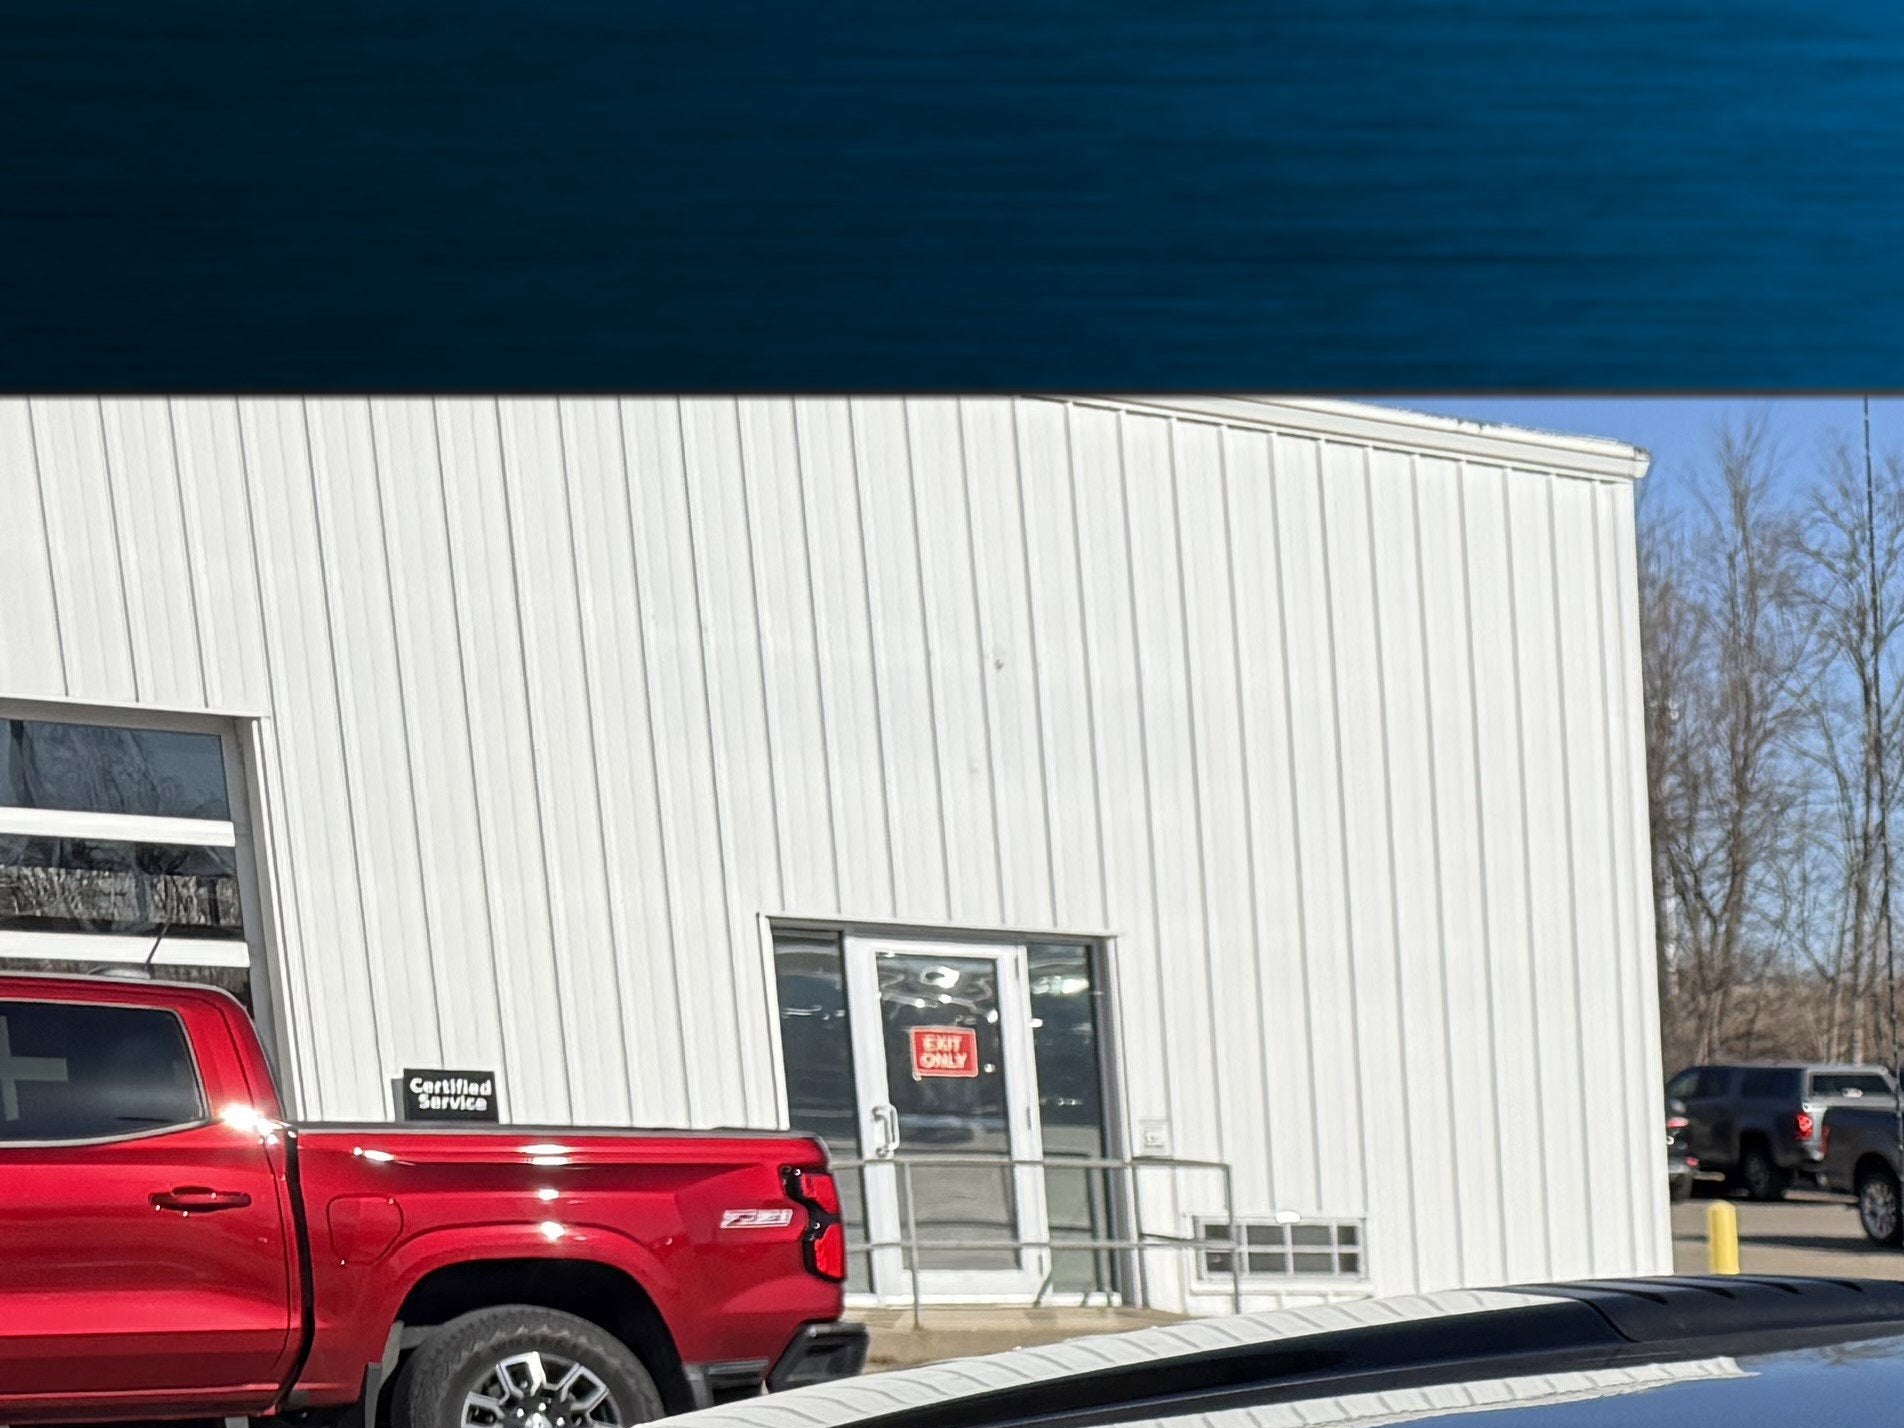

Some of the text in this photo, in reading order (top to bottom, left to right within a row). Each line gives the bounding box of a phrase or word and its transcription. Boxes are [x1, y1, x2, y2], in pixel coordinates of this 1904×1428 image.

[922, 1033, 962, 1052] EXIT
[919, 1051, 968, 1069] ONLY
[409, 1077, 492, 1096] Certified
[418, 1093, 487, 1111] Service
